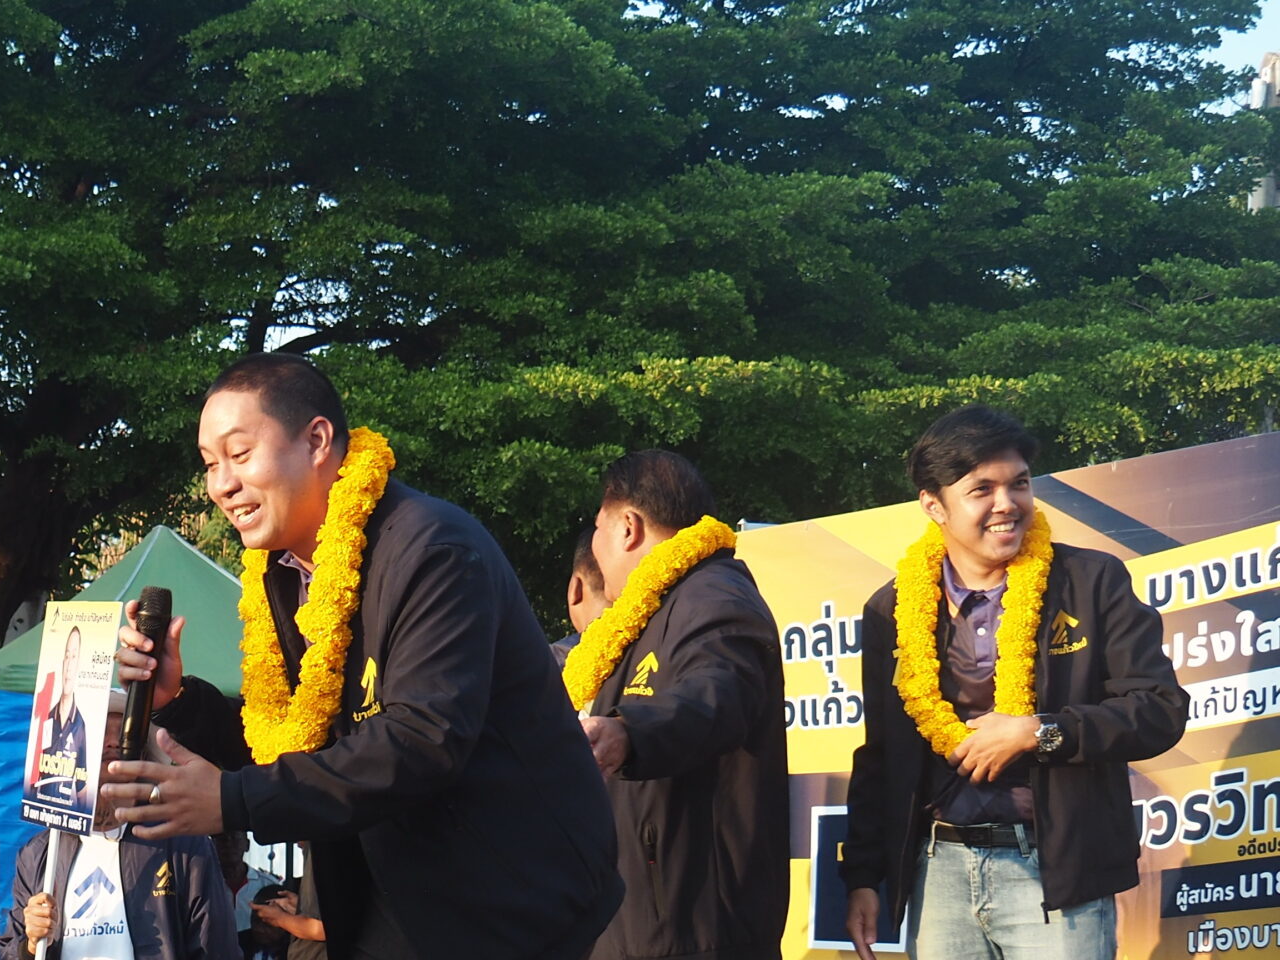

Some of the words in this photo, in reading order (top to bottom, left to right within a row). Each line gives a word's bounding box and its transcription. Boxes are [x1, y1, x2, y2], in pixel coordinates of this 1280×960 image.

[784, 605, 863, 673] กลุ่ม
[1176, 882, 1235, 912] ผู้สมัคร
